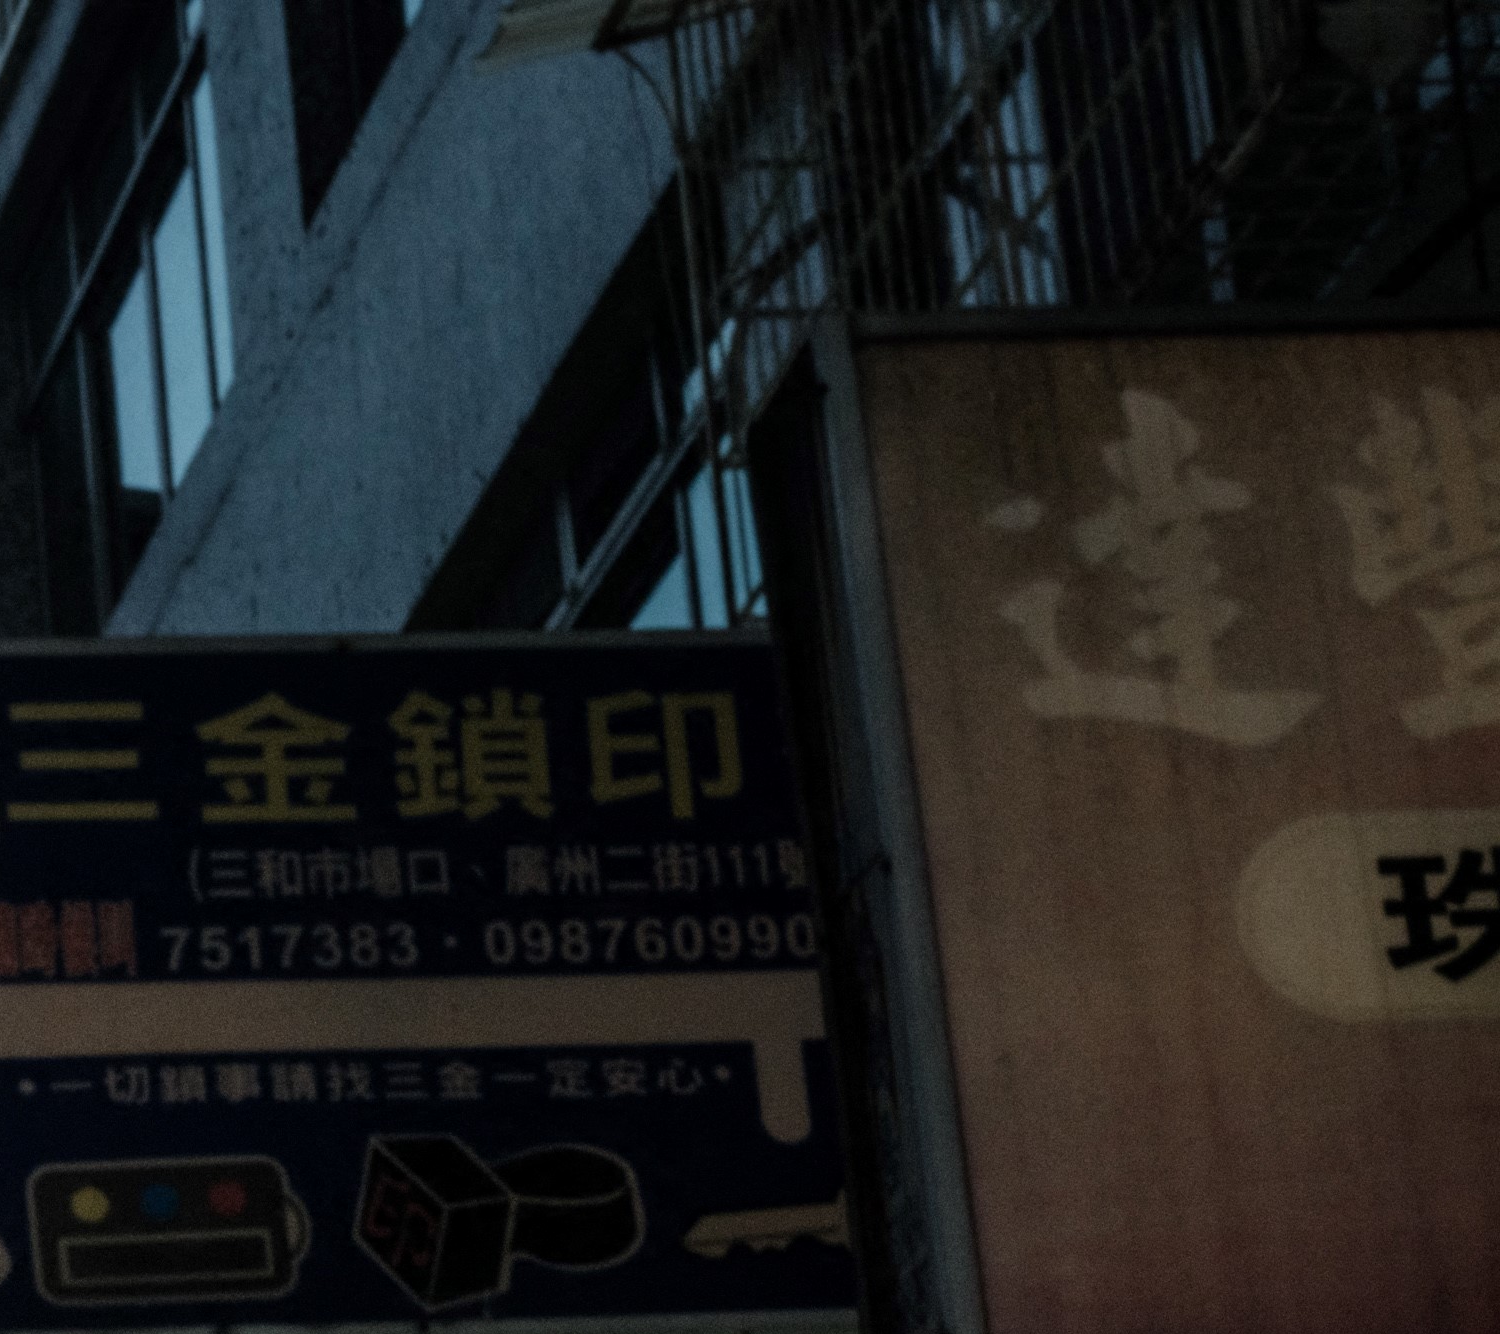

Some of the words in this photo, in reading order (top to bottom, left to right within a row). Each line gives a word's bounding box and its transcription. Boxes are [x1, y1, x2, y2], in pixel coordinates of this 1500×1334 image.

[6, 690, 750, 823] 三金鎖印
[160, 920, 421, 976] 7517383
